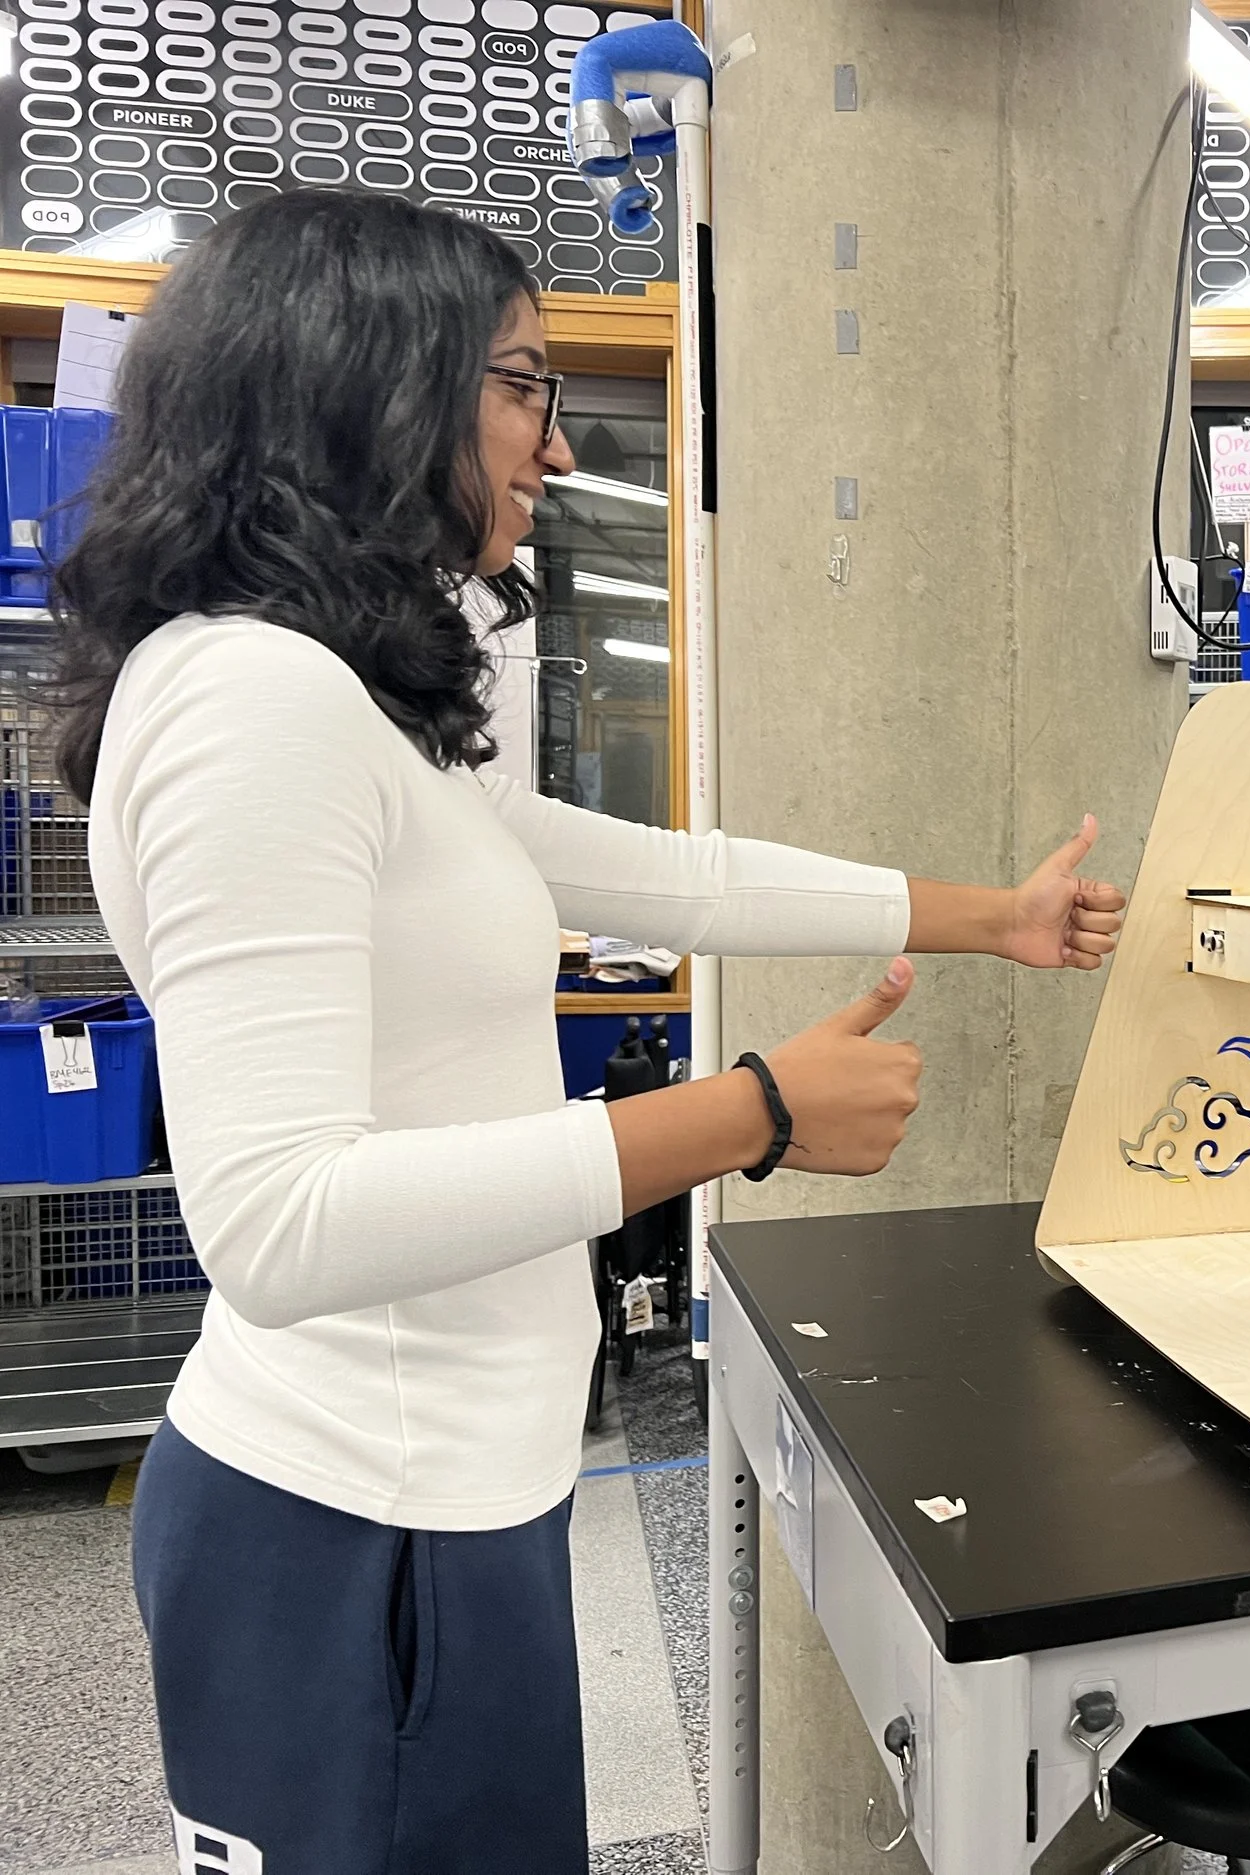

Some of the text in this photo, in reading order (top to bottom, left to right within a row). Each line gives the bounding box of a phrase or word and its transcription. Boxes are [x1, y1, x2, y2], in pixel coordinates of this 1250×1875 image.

[327, 93, 376, 110] DUKE
[113, 109, 194, 129] PIONEER
[513, 145, 573, 163] ORCHE
